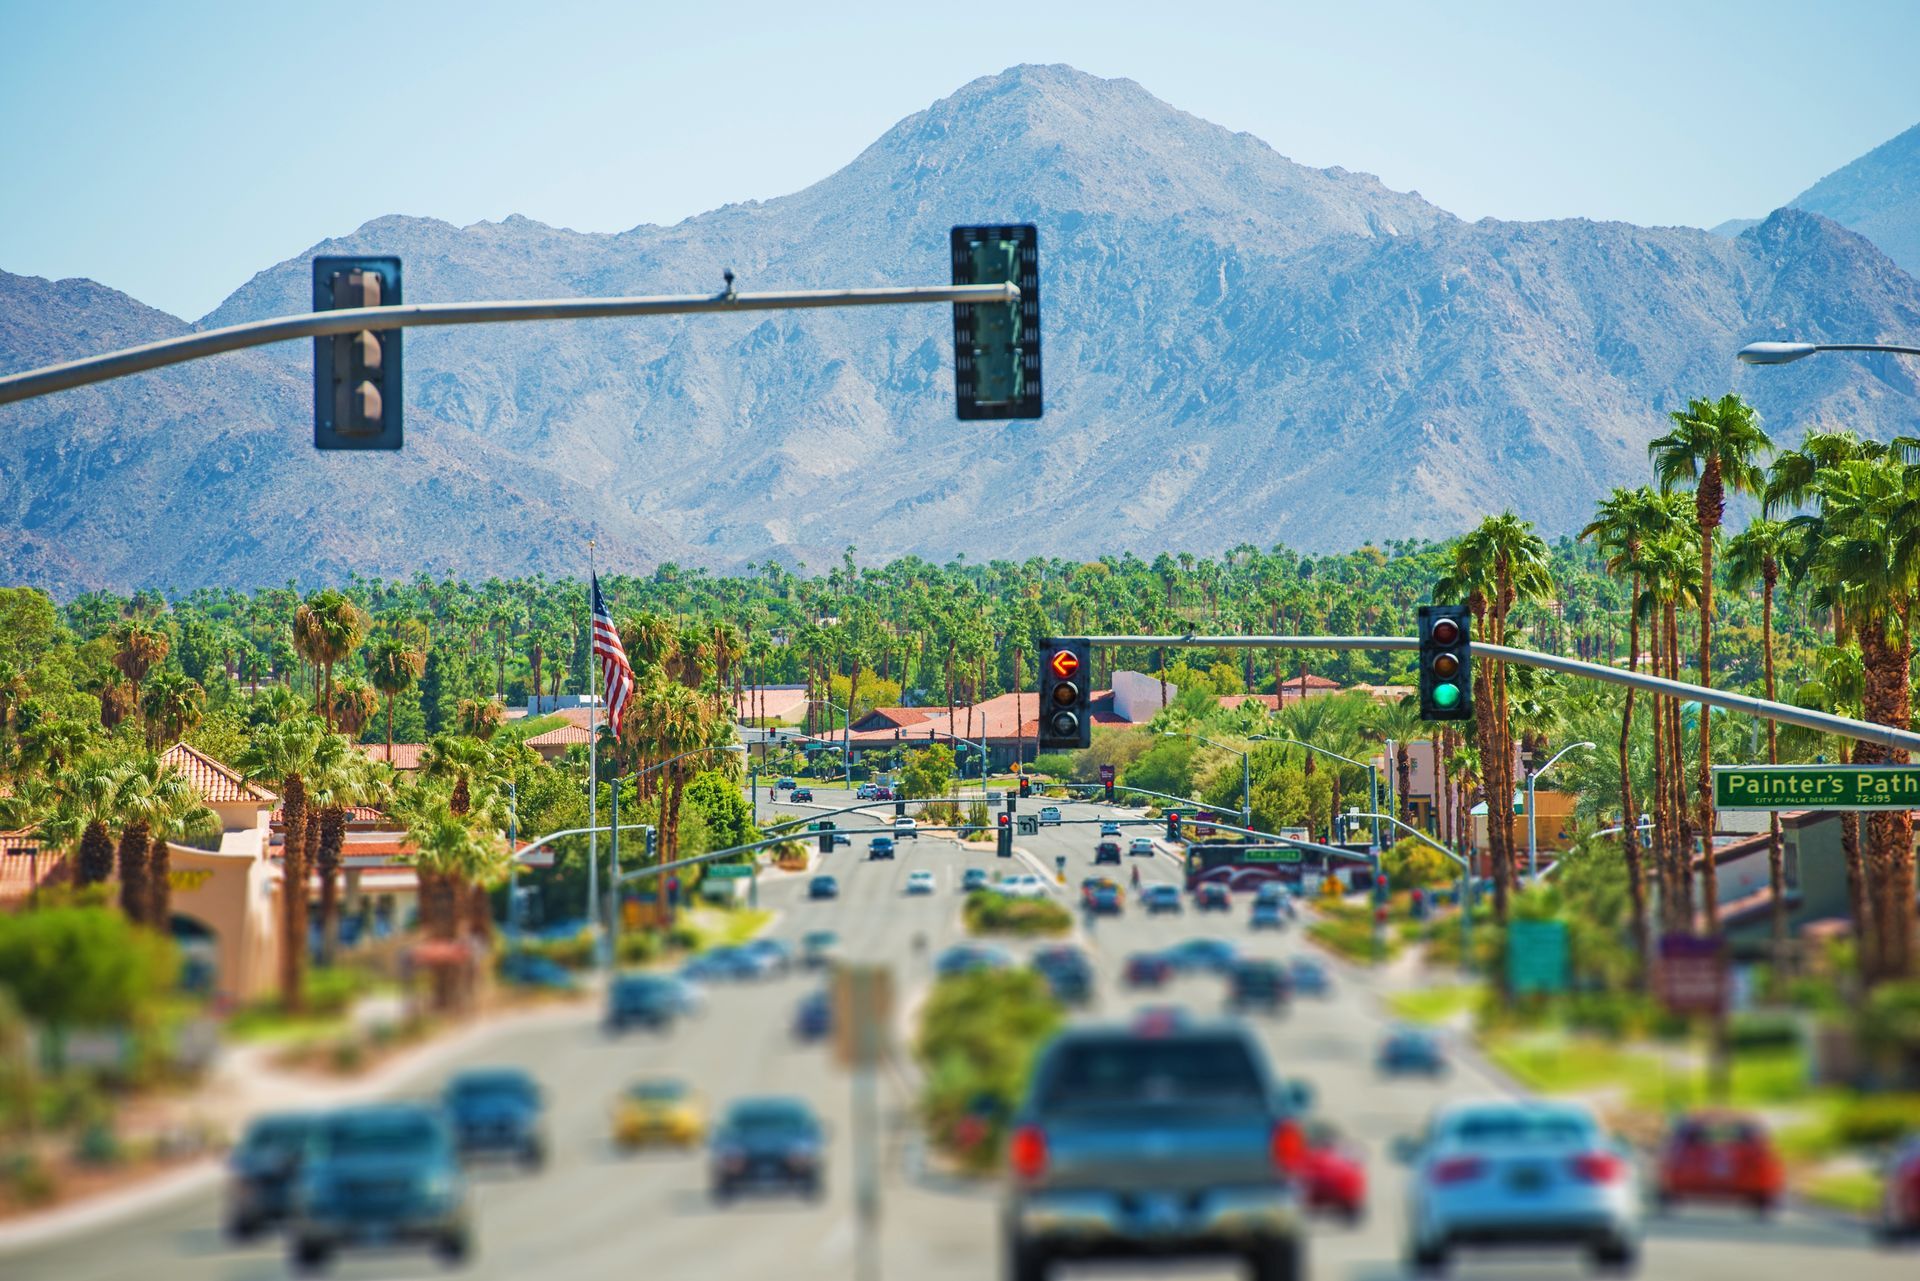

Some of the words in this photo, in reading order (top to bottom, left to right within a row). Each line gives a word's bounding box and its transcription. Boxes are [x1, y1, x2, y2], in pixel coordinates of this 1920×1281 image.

[1729, 775, 1844, 793] Painter's
[1857, 774, 1918, 793] Path
[1856, 794, 1891, 803] 72-195
